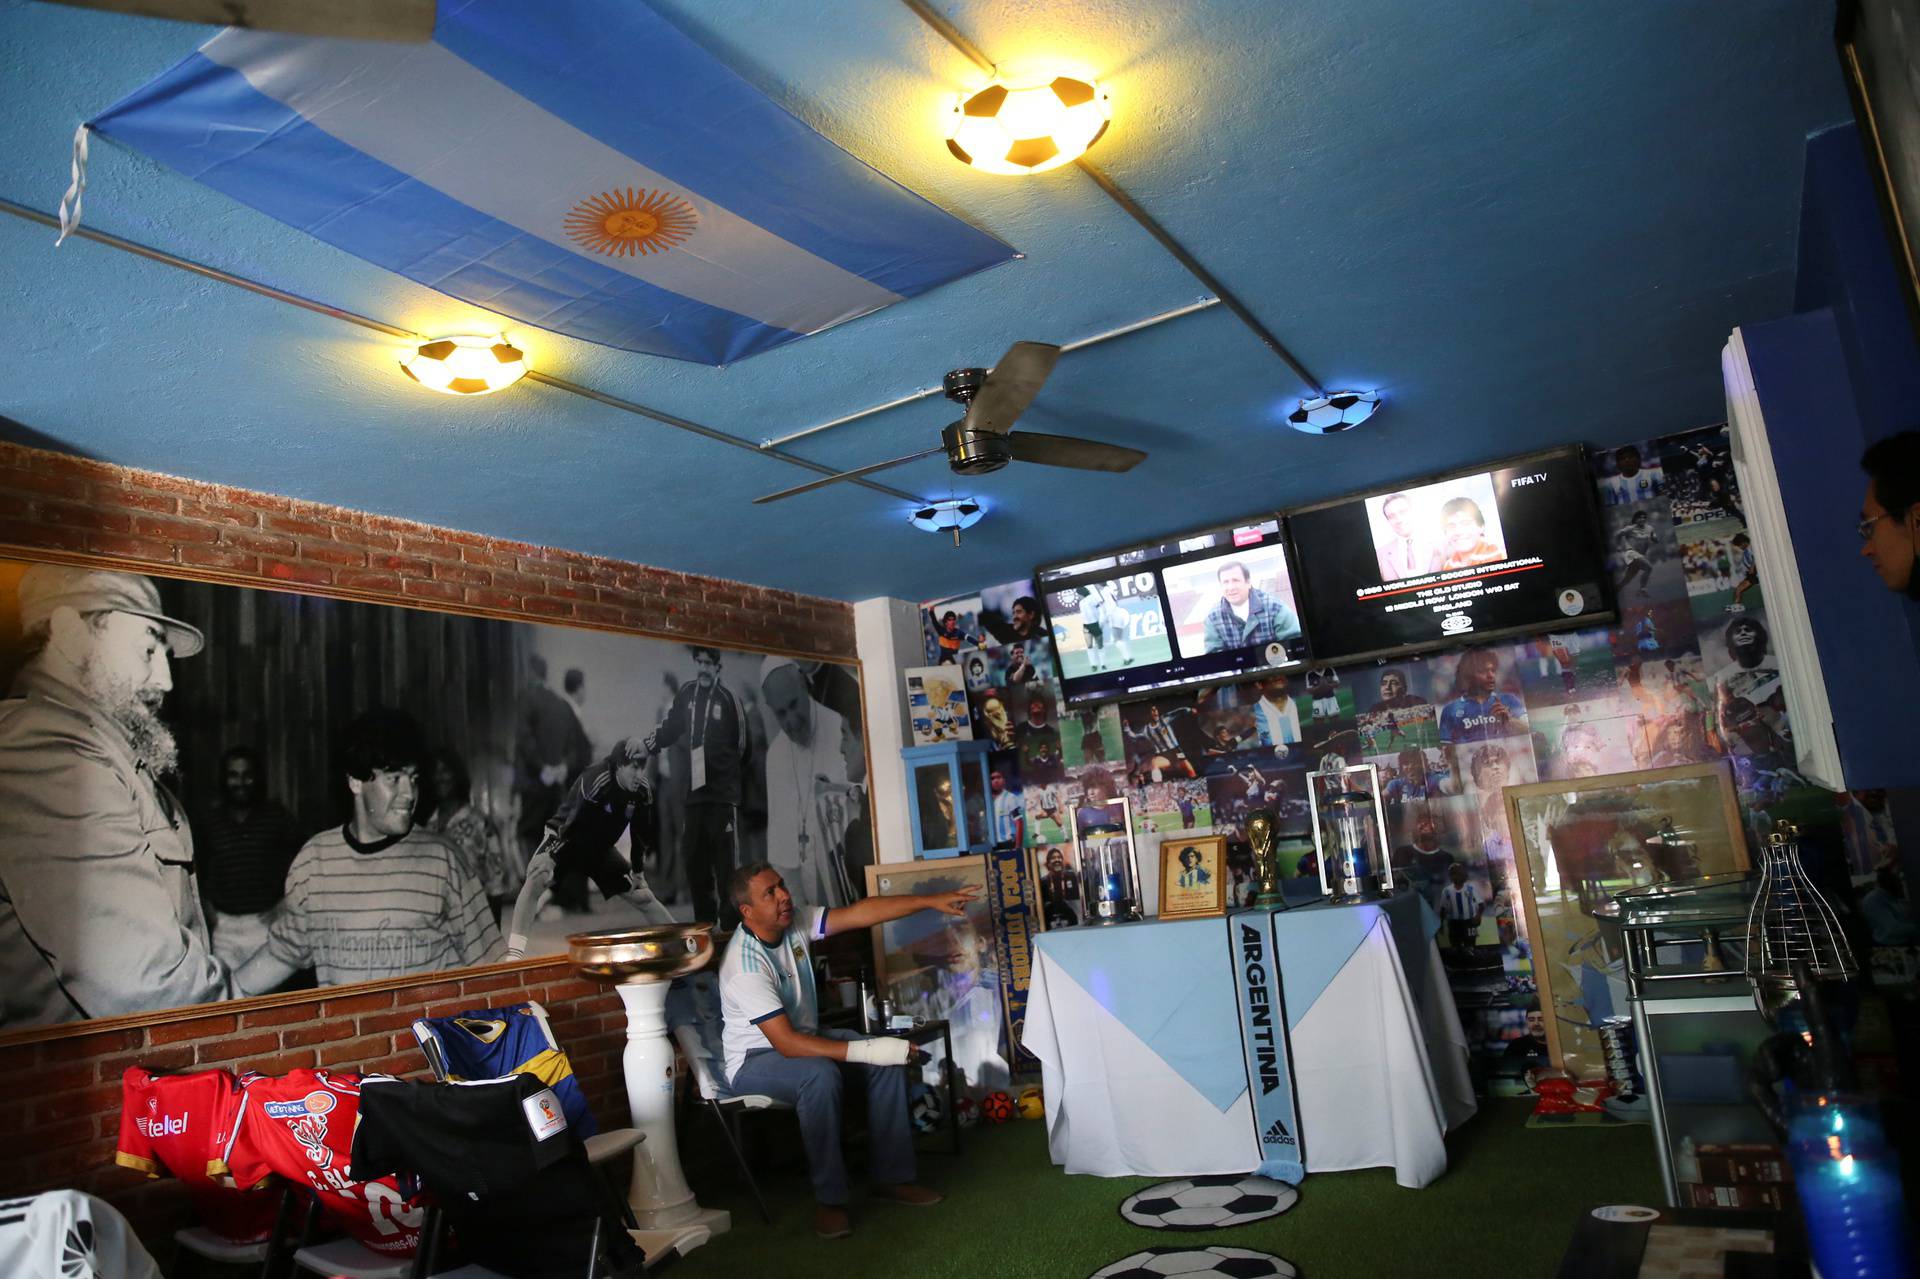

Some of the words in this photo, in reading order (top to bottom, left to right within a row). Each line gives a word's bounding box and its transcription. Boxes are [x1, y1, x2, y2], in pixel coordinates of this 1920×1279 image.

[1511, 476, 1534, 488] FIFA
[1534, 472, 1547, 482] TV
[1476, 557, 1543, 574] INTERNATIONAL
[1394, 600, 1424, 611] MIDDLE
[1425, 596, 1445, 605] ROW
[1449, 589, 1484, 601] LONDON
[1485, 585, 1503, 594] W10
[1416, 589, 1433, 598] THE
[1433, 586, 1451, 595] OLD
[1452, 580, 1483, 592] STUDIO
[1433, 600, 1473, 613] ENGLAND
[999, 859, 1022, 910] BOCA
[1004, 911, 1031, 992] JUNIORS
[1241, 923, 1280, 1095] ARGENTINA
[1262, 1134, 1295, 1146] adidas
